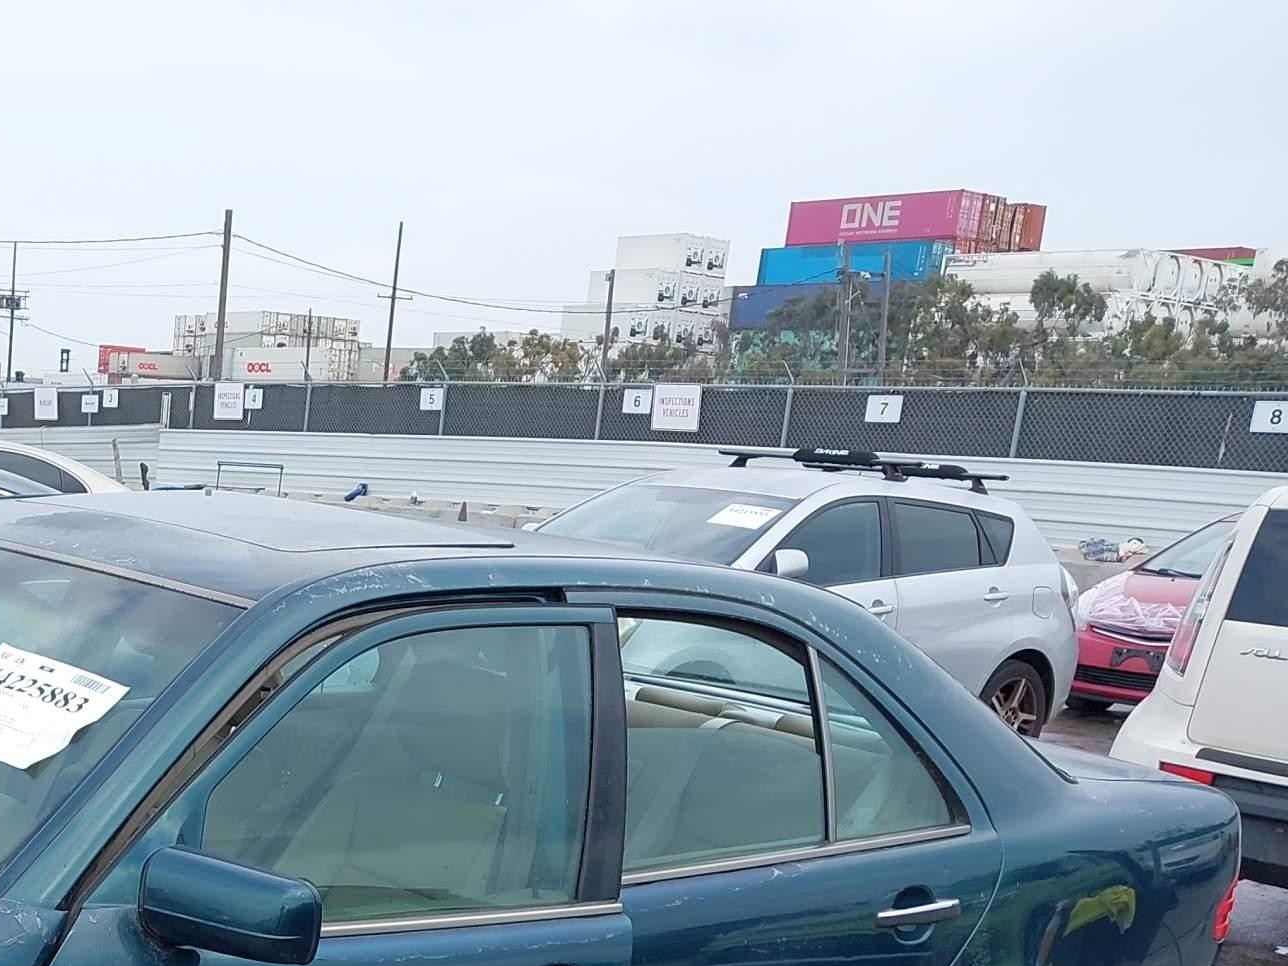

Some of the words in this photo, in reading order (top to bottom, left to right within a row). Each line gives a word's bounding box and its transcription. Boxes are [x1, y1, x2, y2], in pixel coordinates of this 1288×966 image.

[839, 200, 903, 229] ONE
[138, 362, 158, 370] OOCL
[246, 362, 272, 373] OOCL
[428, 393, 435, 405] 5
[633, 395, 642, 408] 6
[658, 397, 696, 407] INSPECTIONS
[662, 408, 689, 418] VEHICLES
[880, 402, 889, 416] 7
[1270, 408, 1283, 425] 8
